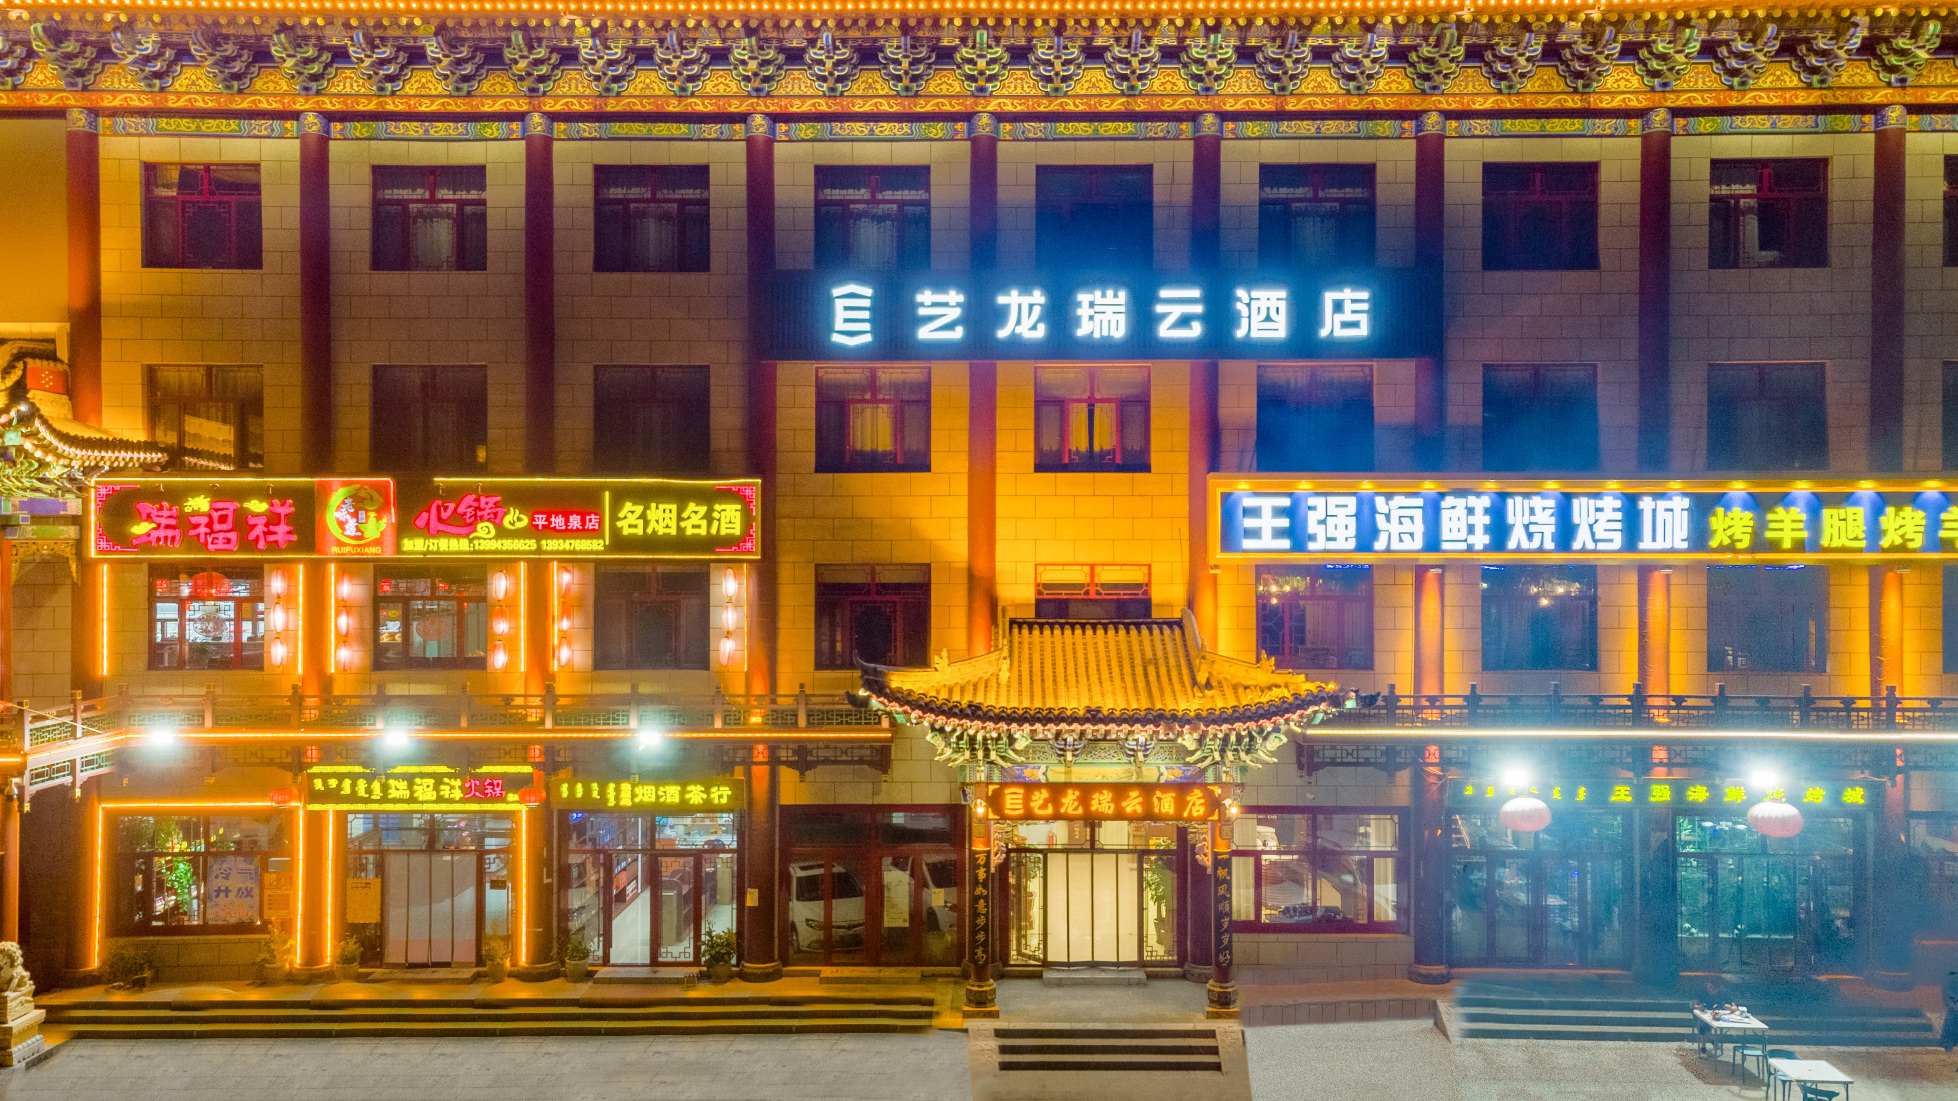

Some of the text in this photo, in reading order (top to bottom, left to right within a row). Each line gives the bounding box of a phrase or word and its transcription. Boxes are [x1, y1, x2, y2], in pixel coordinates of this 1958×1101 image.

[915, 288, 1369, 339] 艺龙瑞云酒店
[131, 498, 297, 551] 瑞福祥
[414, 494, 507, 535] 火锅
[531, 513, 601, 531] 平地泉店
[615, 501, 743, 536] 名烟名酒
[1241, 495, 1691, 551] 王强海鲜烧烤城
[331, 546, 382, 554] RUIFUXIANG
[540, 538, 605, 551] 13934768582
[387, 777, 464, 801] 瑞福祥
[464, 778, 506, 799] 火锅
[634, 784, 733, 805] 烟酒茶行
[1029, 788, 1207, 818] 艺龙瑞云酒店
[974, 852, 988, 964] 万事如意步步高
